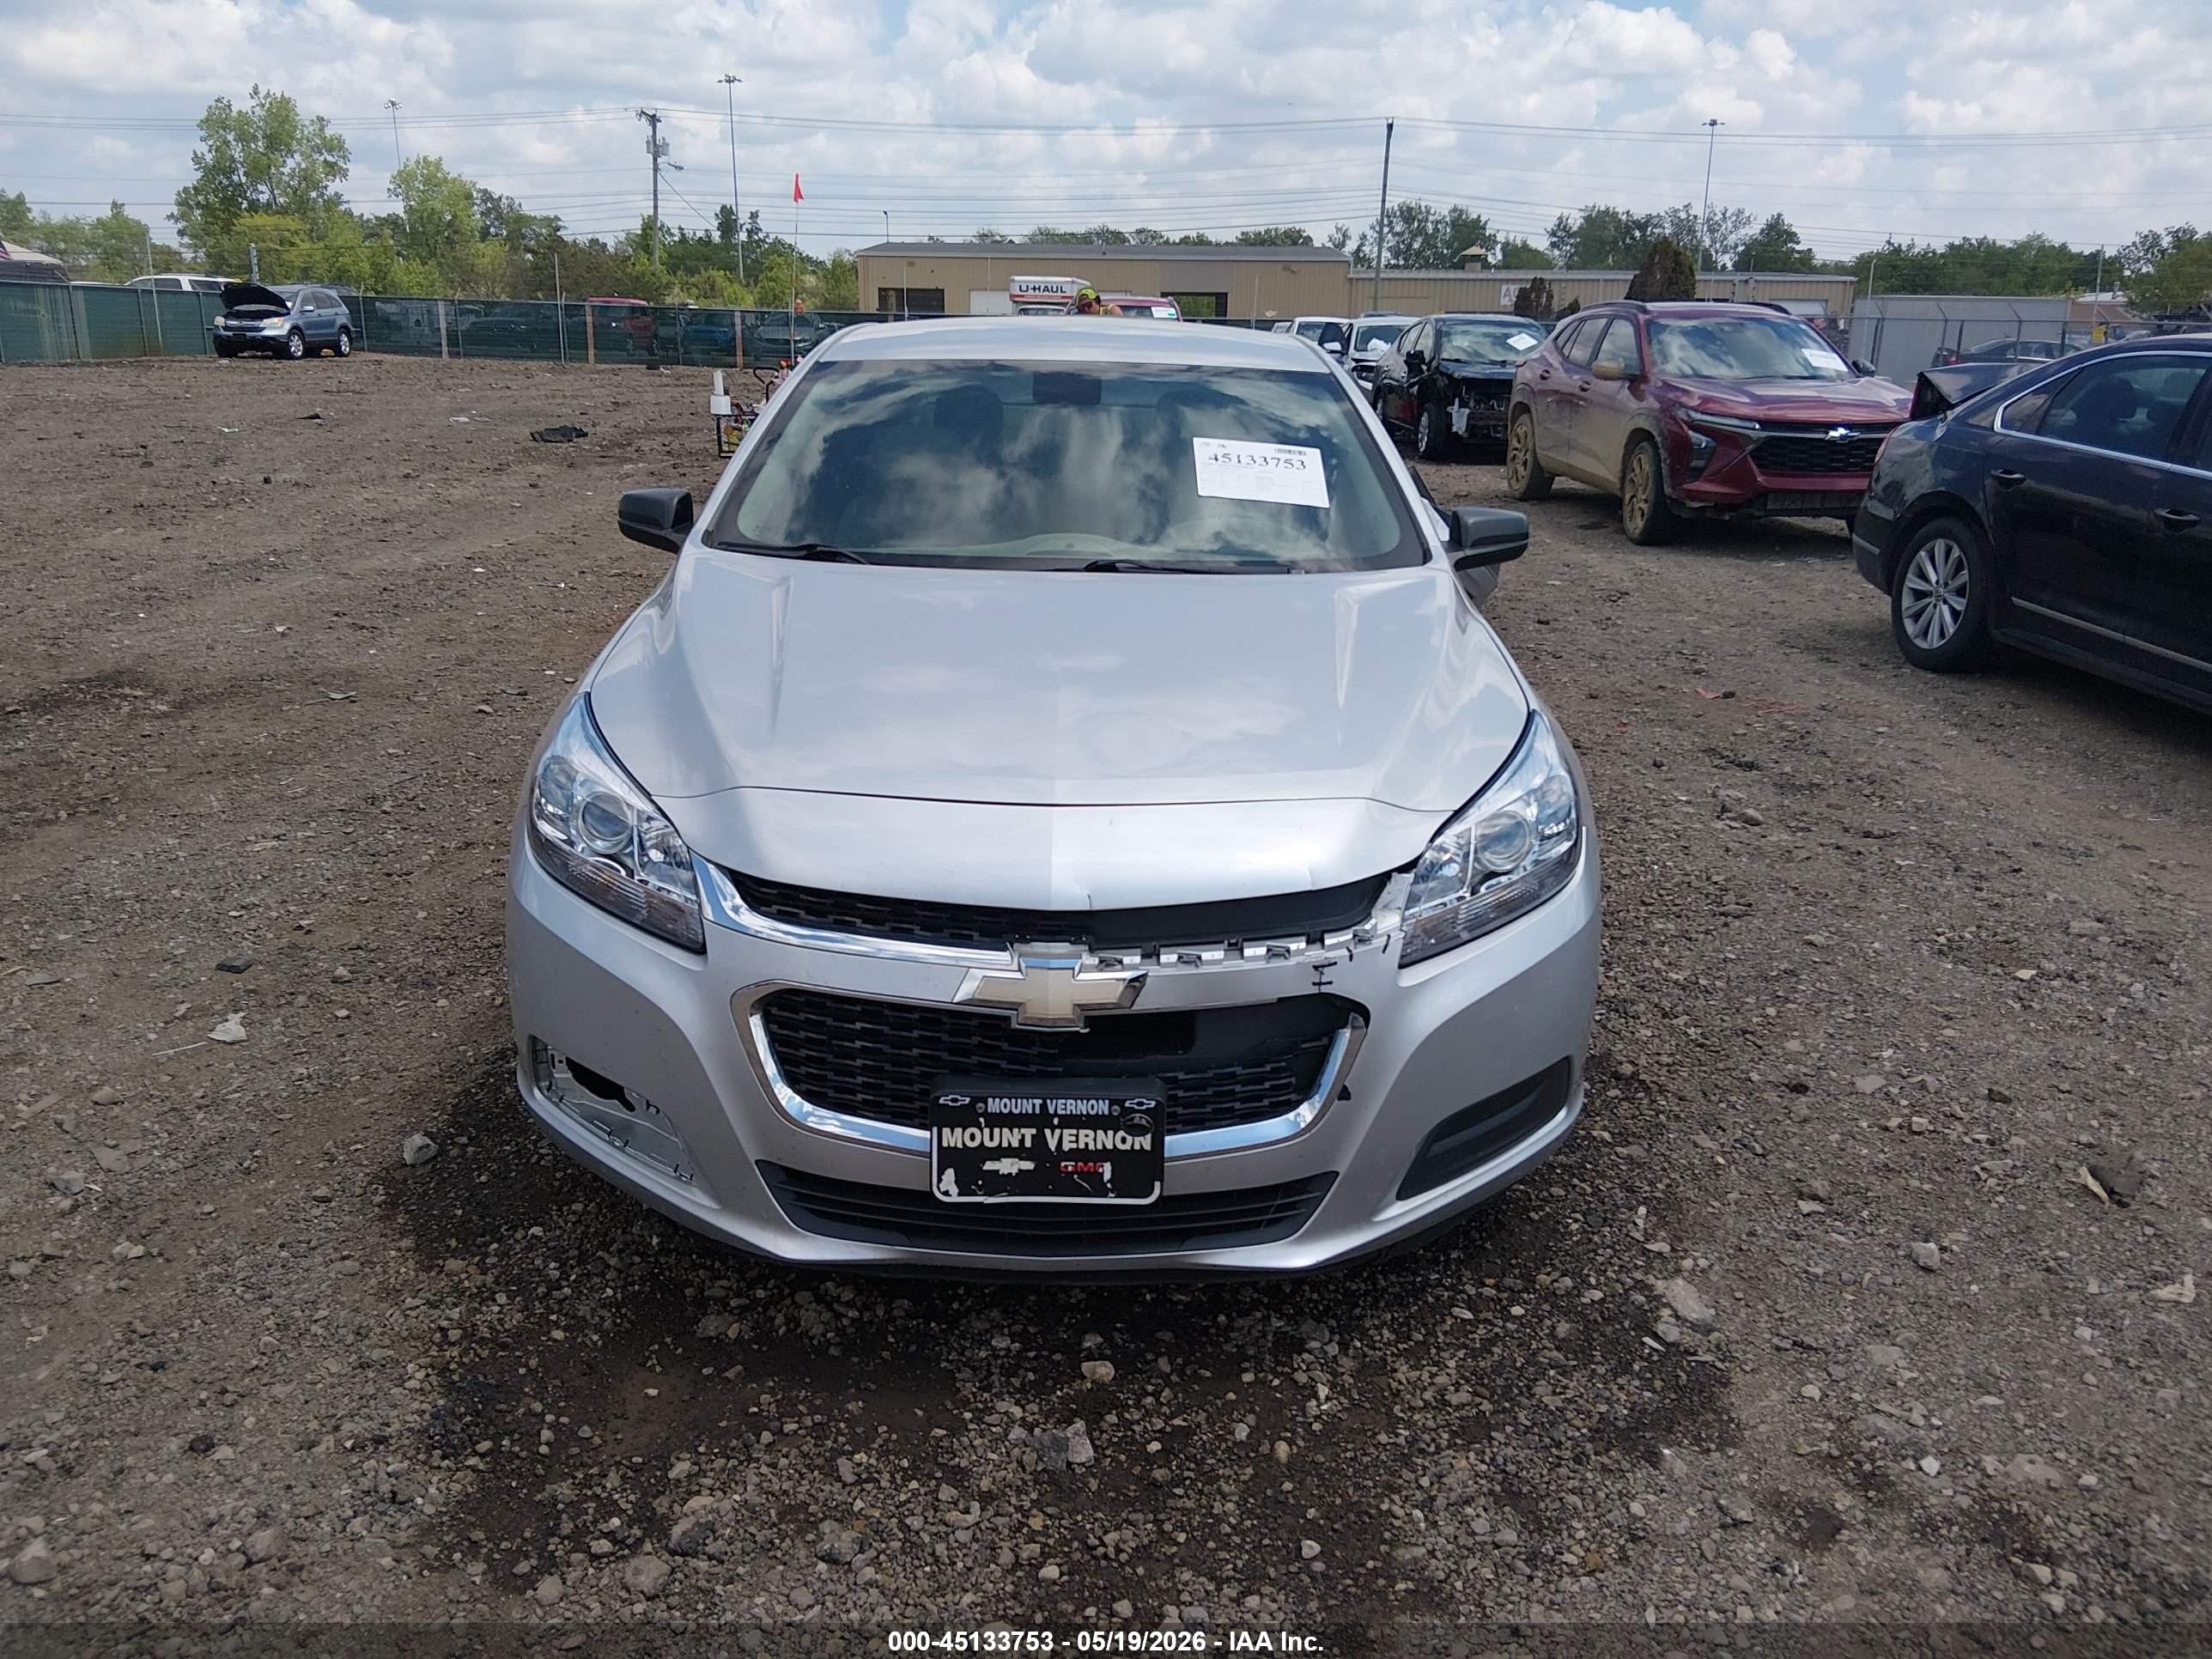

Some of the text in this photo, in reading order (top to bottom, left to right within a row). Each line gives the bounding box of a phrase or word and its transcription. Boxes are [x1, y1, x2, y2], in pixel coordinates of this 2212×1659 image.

[1018, 284, 1067, 294] U-HAUL
[1208, 453, 1306, 471] 45133753
[988, 1097, 1109, 1115] MOUNT VERNON
[942, 1127, 1152, 1152] MOUNT VERNON
